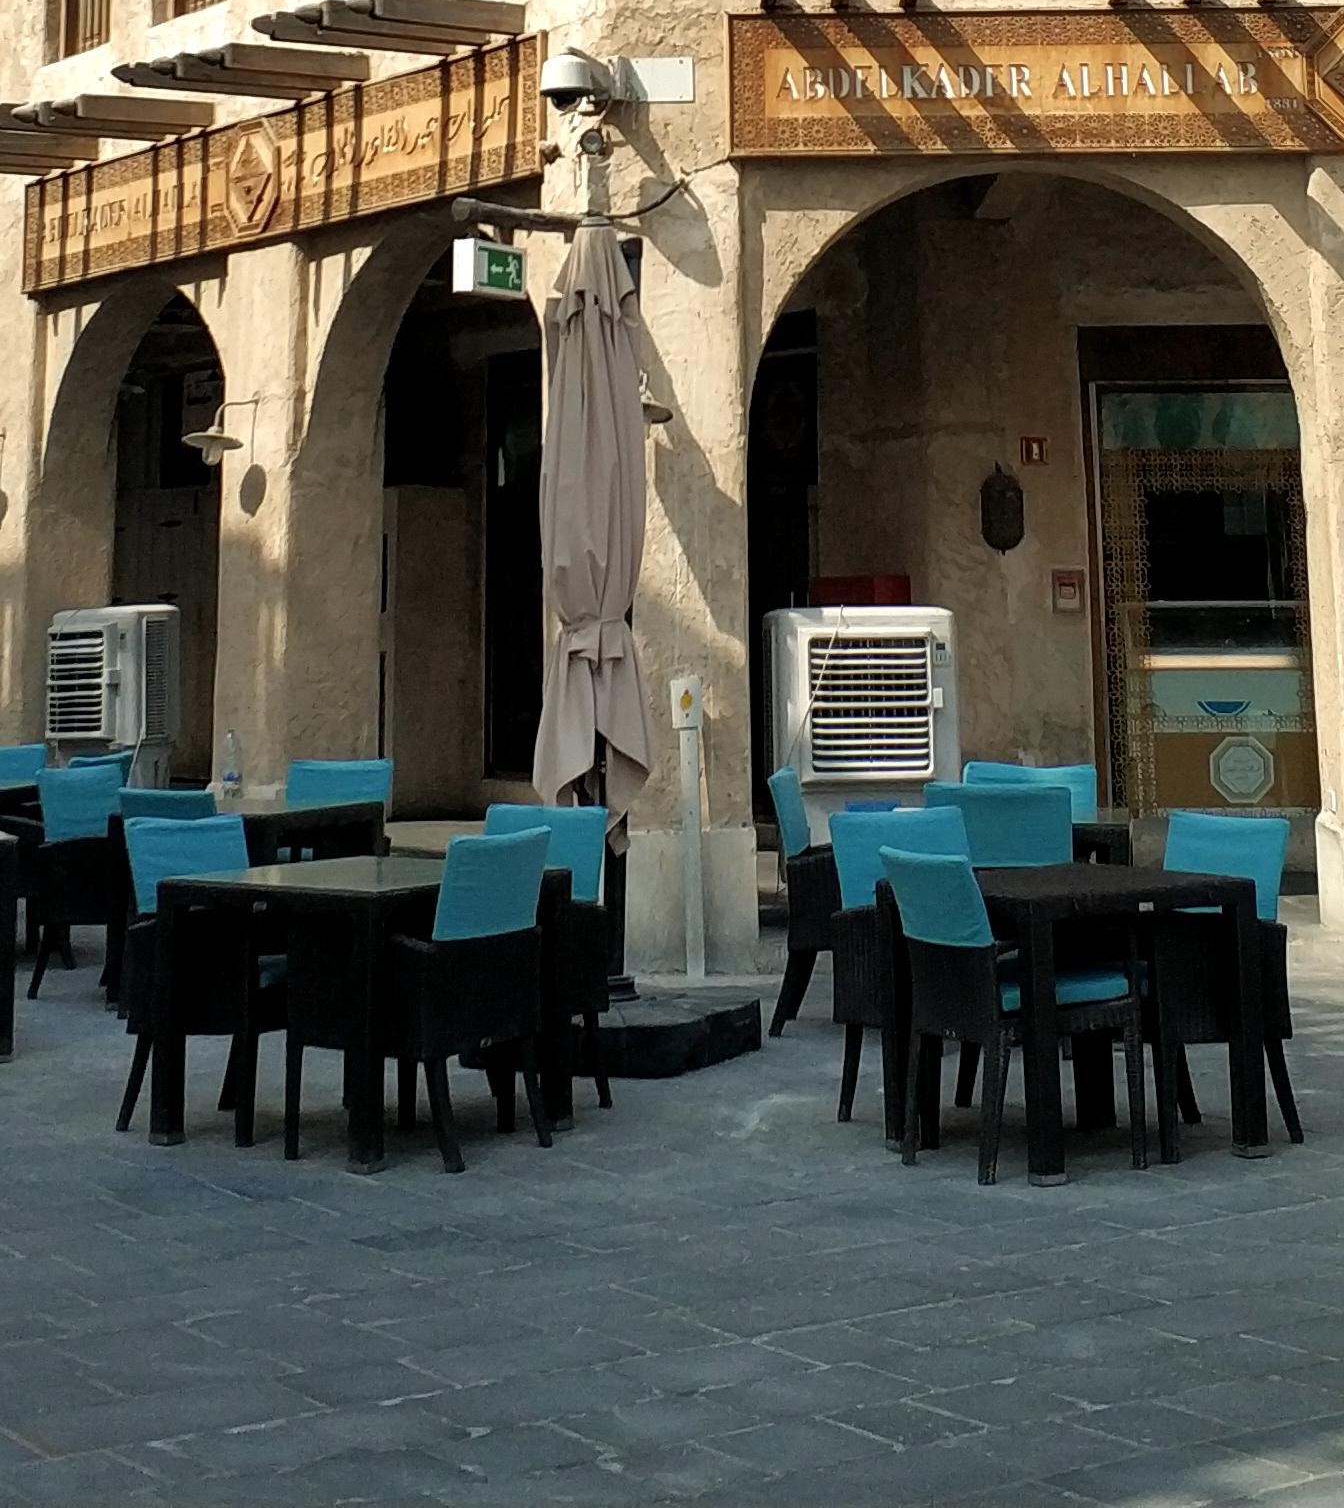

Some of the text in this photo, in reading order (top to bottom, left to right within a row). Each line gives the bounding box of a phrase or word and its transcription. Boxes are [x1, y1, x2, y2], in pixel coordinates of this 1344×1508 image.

[776, 62, 1260, 100] ABDELKADER ALHALLAB
[1265, 96, 1299, 110] 1881
